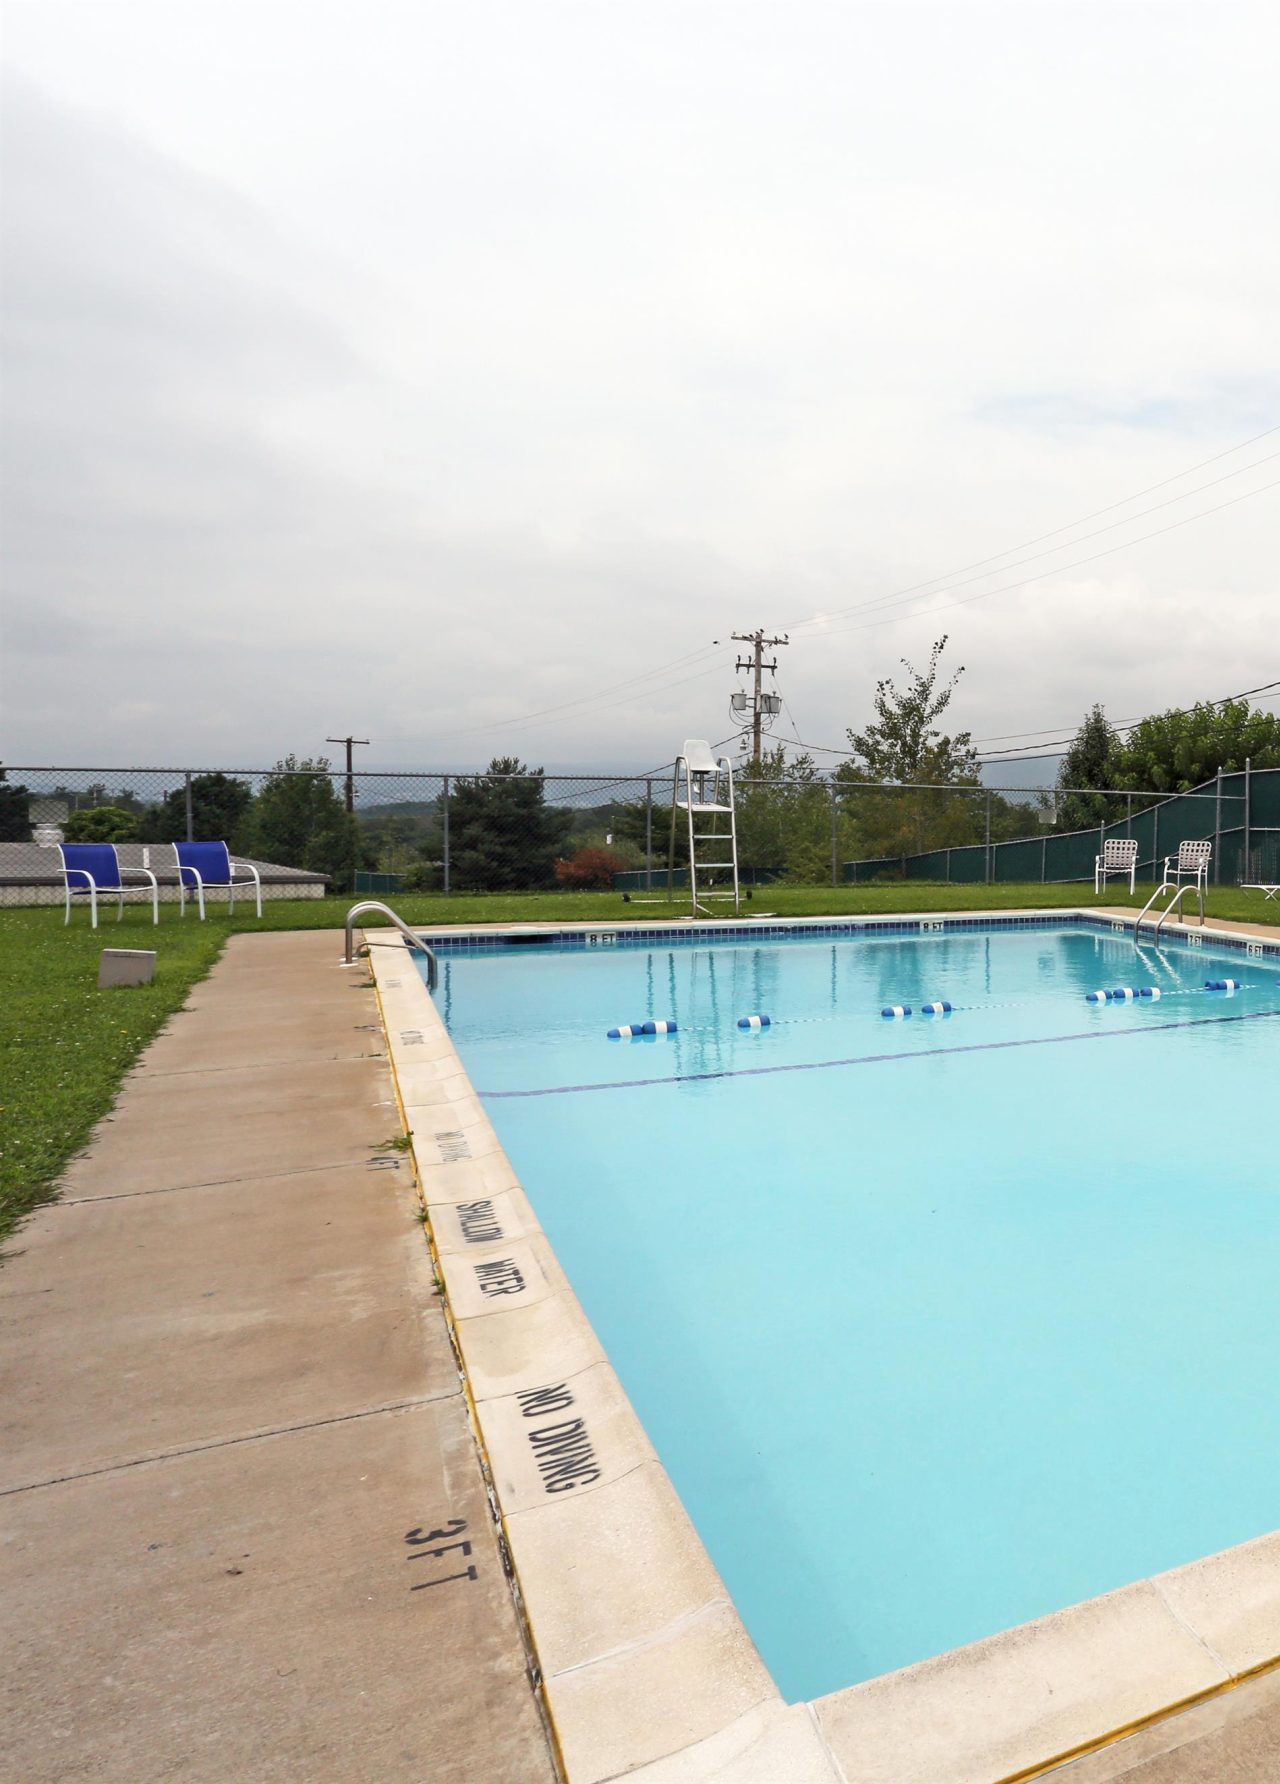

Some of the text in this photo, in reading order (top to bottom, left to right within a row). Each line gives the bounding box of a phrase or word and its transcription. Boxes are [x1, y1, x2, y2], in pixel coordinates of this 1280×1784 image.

[590, 933, 615, 942] 8 FT
[456, 1200, 505, 1244] SHALLOW
[473, 1258, 527, 1298] WATER
[516, 1383, 601, 1494] NO DIVING
